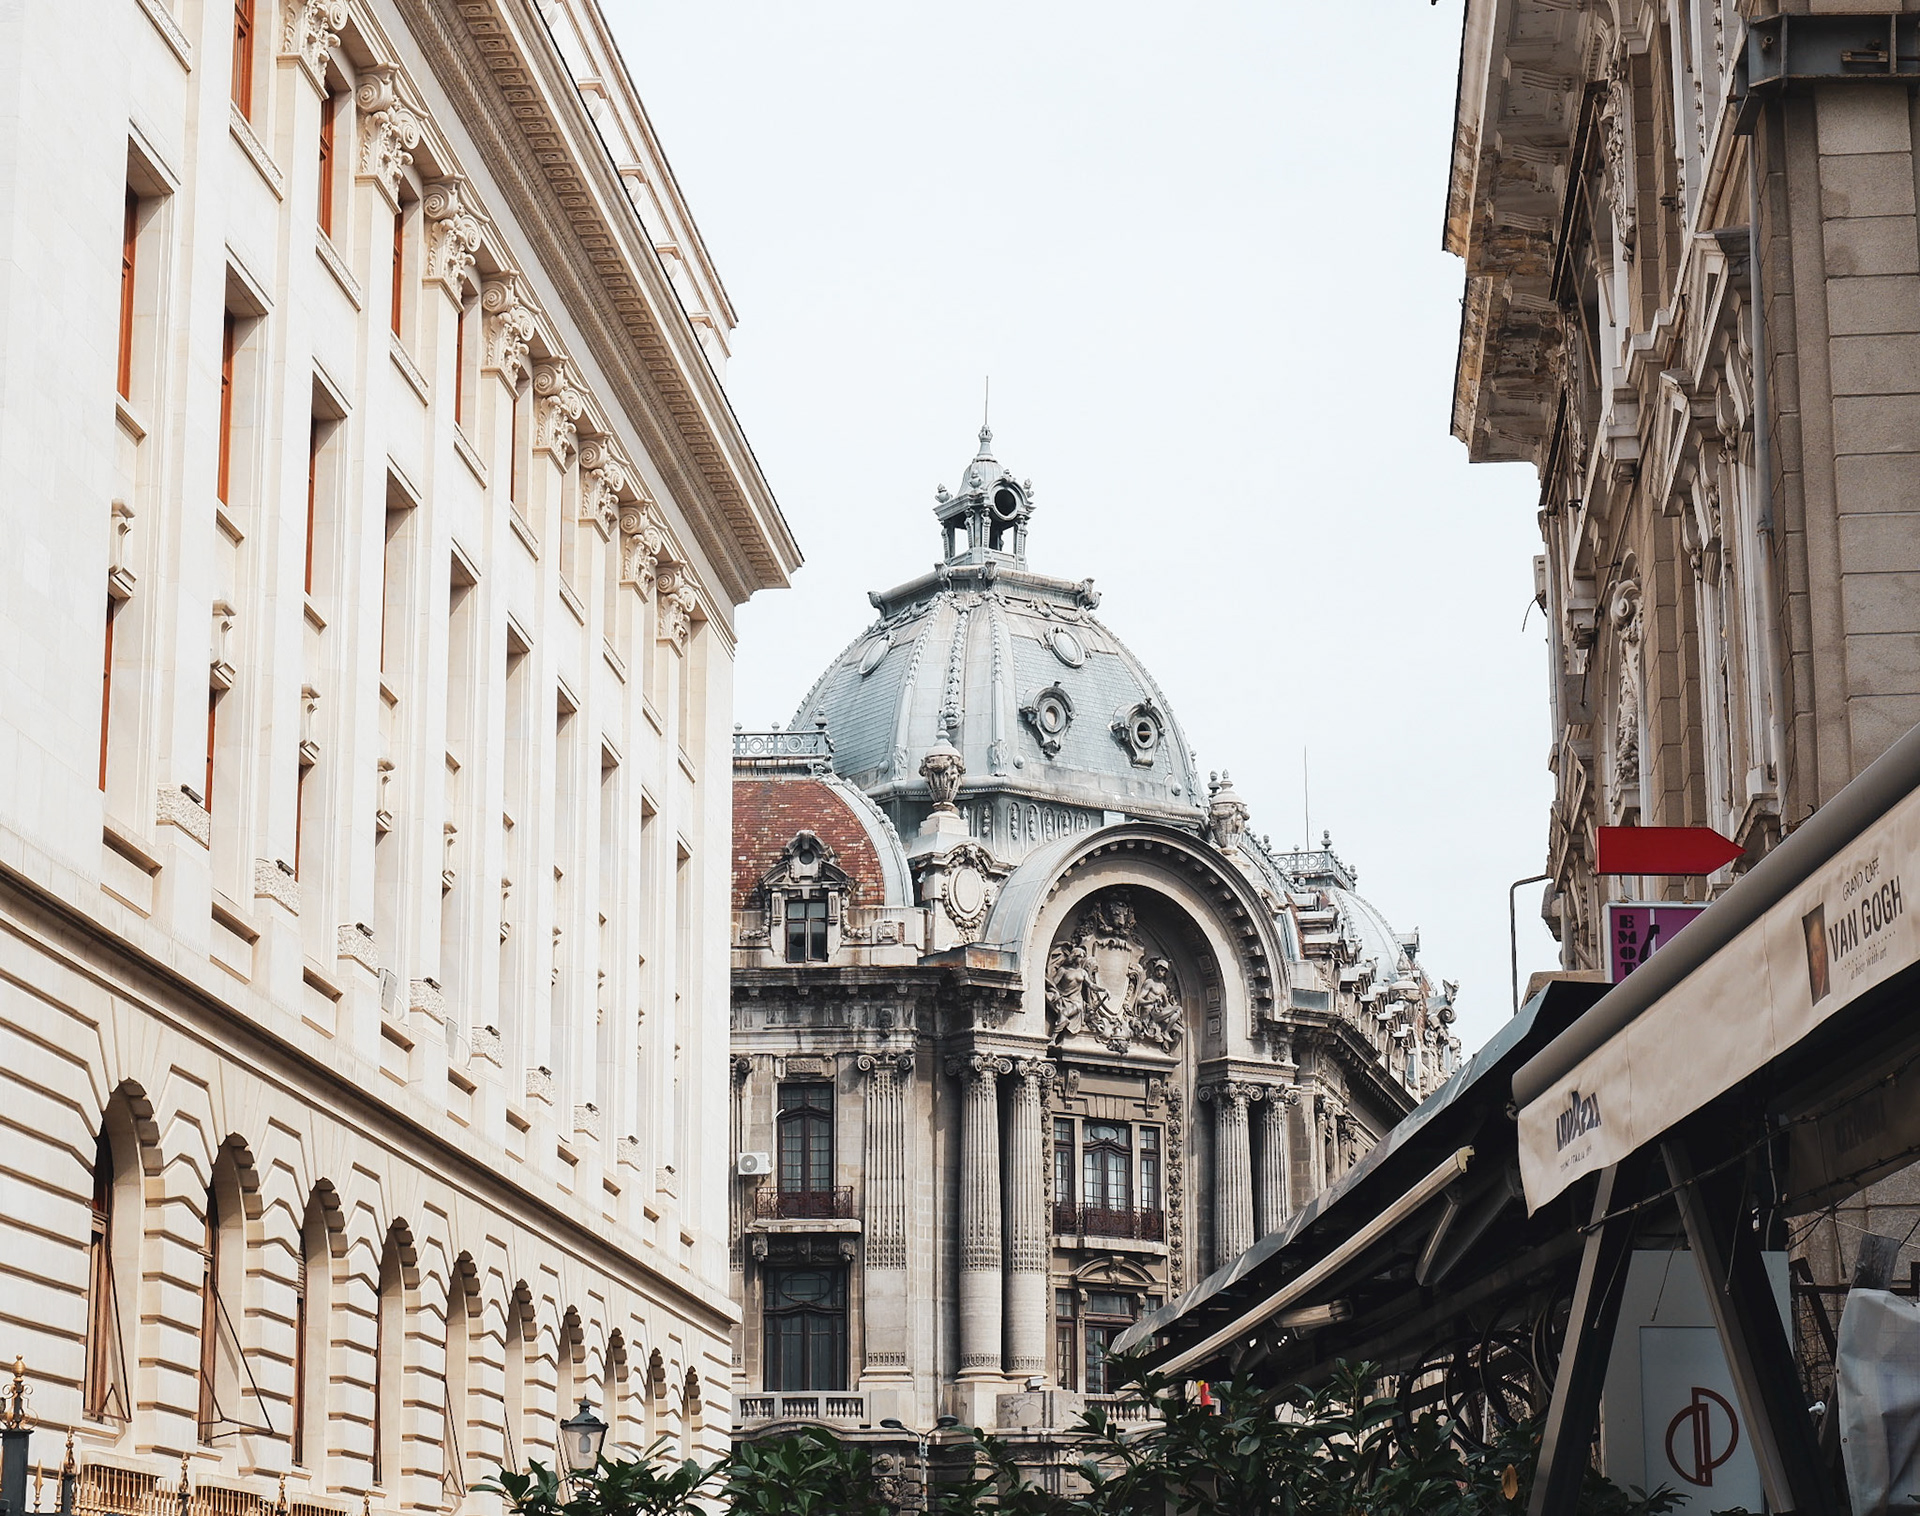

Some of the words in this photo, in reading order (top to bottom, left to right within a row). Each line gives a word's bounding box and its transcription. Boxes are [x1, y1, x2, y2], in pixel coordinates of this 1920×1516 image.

[1843, 871, 1863, 901] GRAND
[1829, 909, 1859, 962] VAN
[1861, 875, 1903, 939] GOGH
[1556, 1091, 1602, 1152] LAVAZZA
